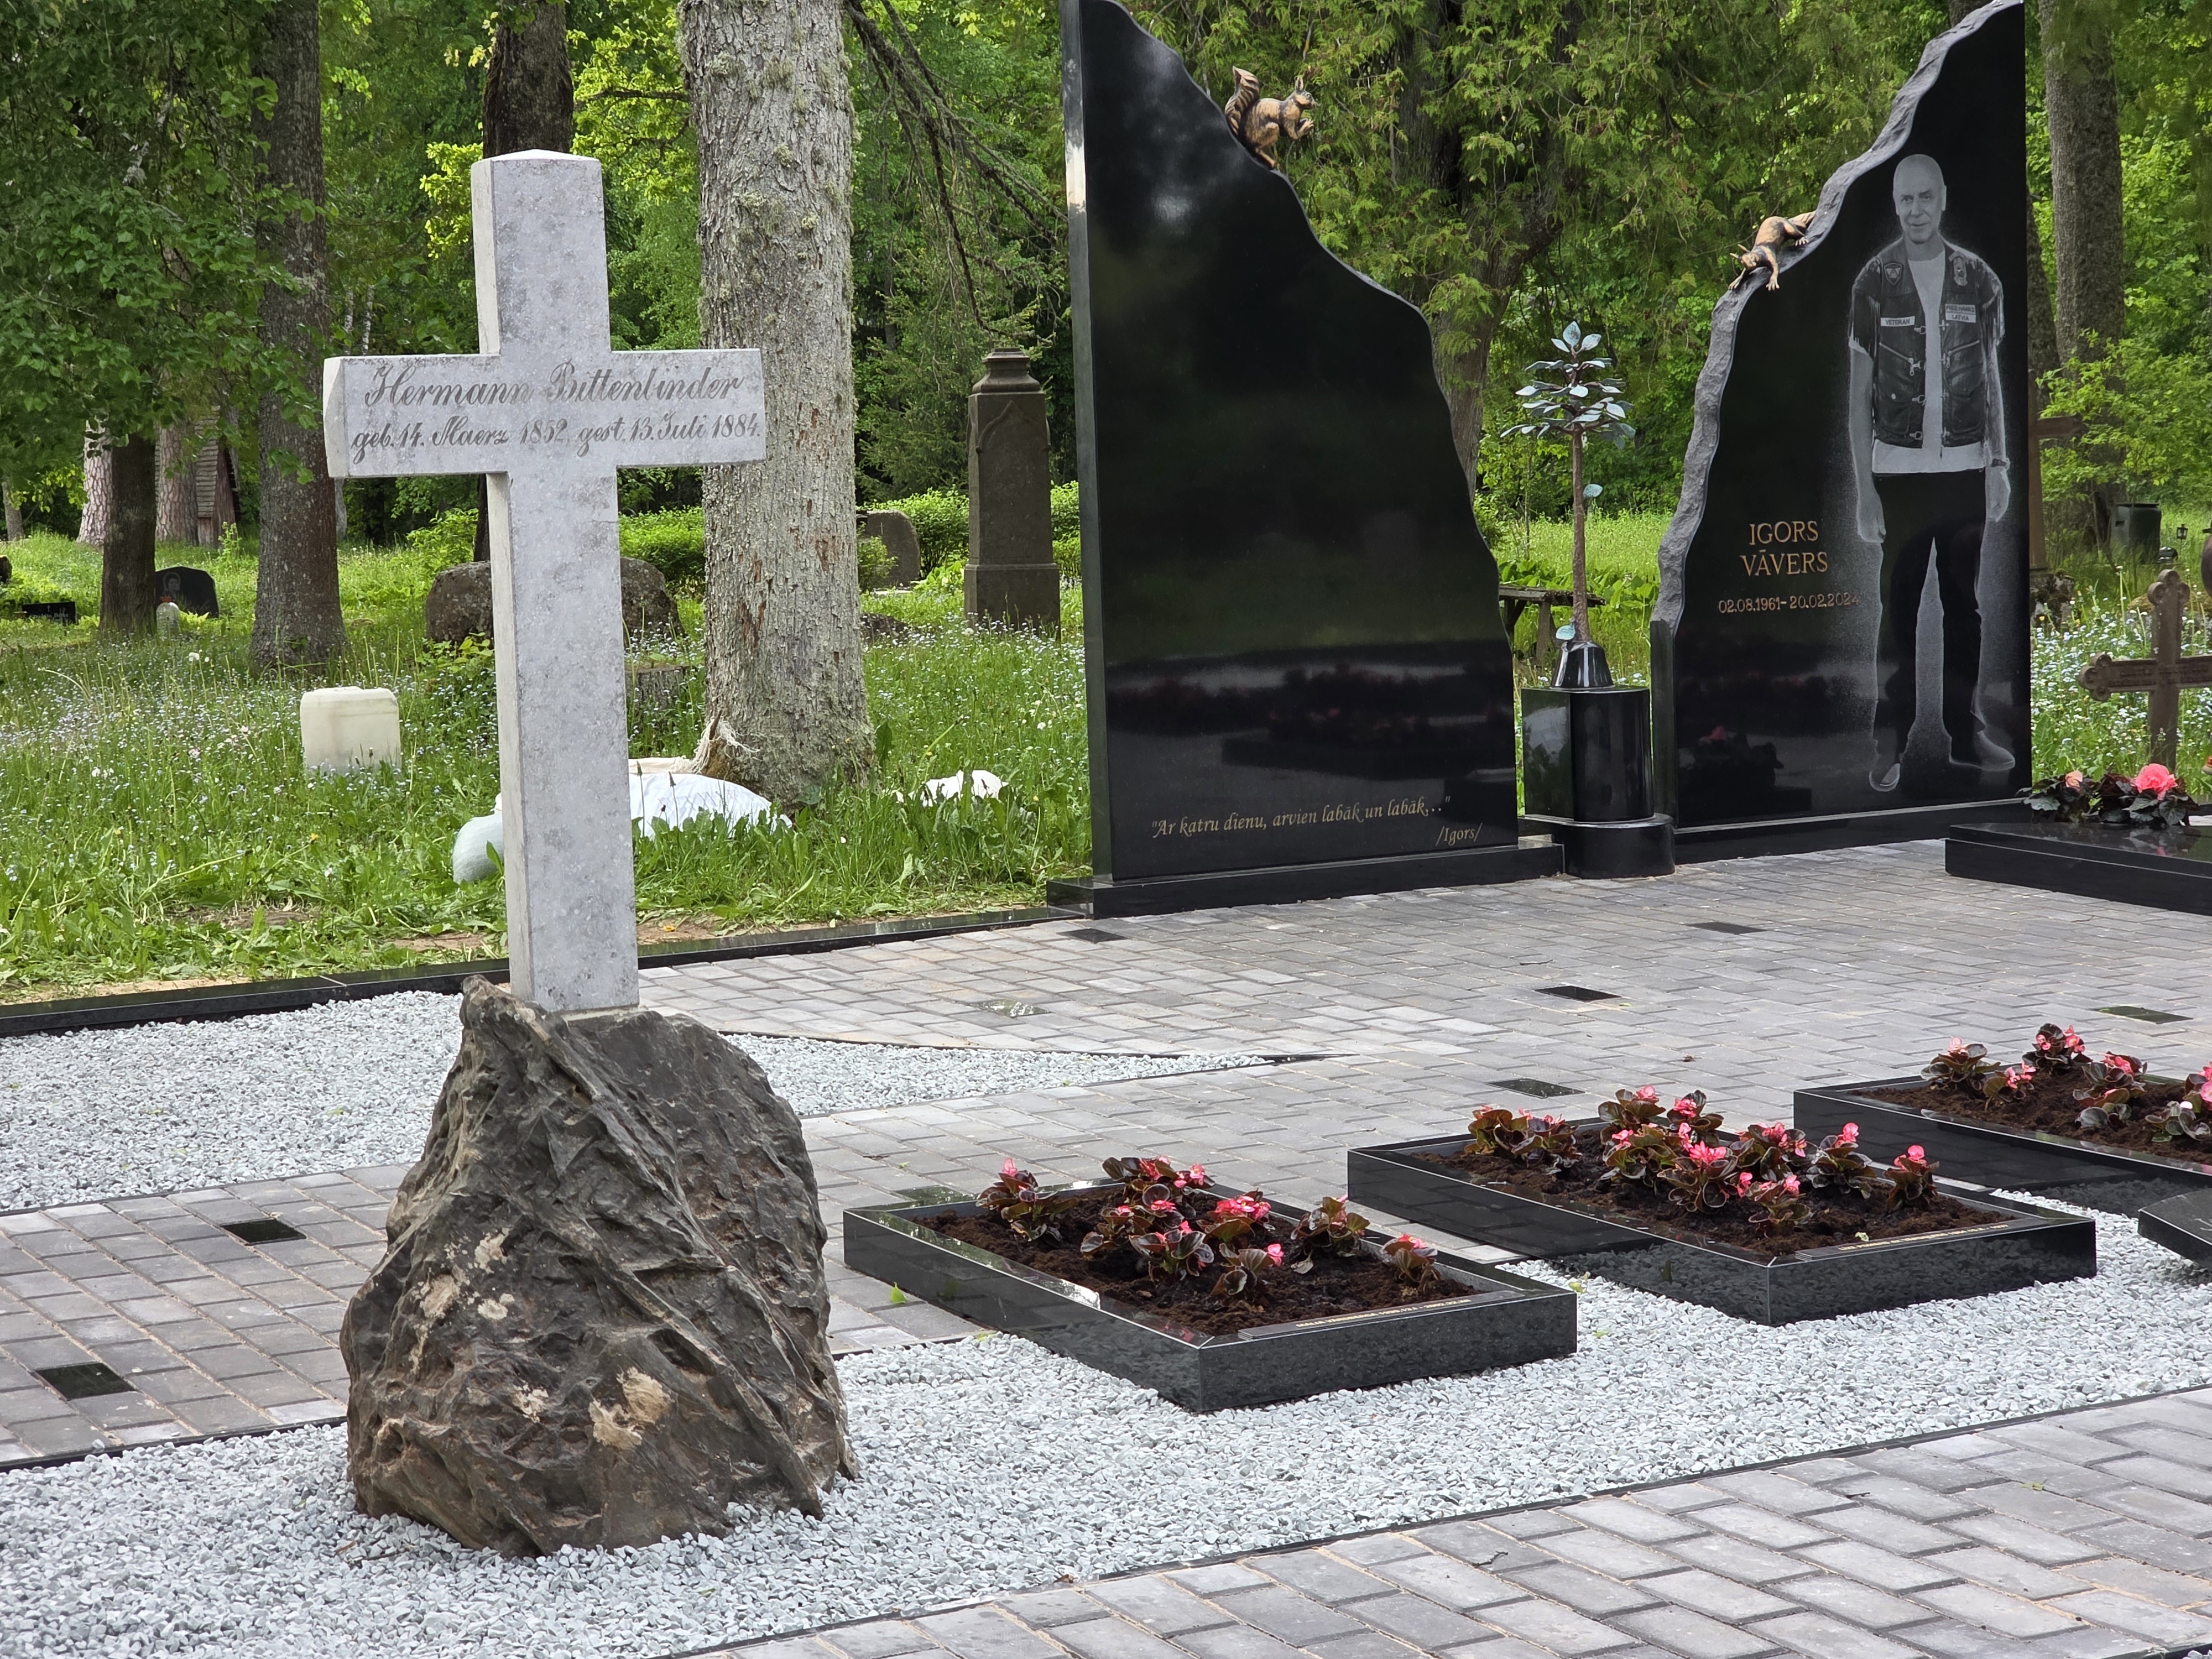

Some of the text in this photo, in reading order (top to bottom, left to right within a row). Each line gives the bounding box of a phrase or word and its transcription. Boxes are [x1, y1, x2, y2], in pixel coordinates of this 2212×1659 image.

[364, 364, 535, 406] Hermann
[431, 415, 509, 447] Maerz
[656, 411, 708, 441] Juli
[711, 412, 761, 440] 1884.
[1749, 520, 1819, 545] IGORS
[1739, 549, 1829, 577] VĀVERS
[1179, 816, 1219, 837] katru
[1223, 812, 1267, 831] dienu,
[1272, 808, 1318, 827] arvien
[1322, 802, 1364, 823] labāk
[1364, 806, 1383, 818] un
[1435, 822, 1483, 847] /Igors/
